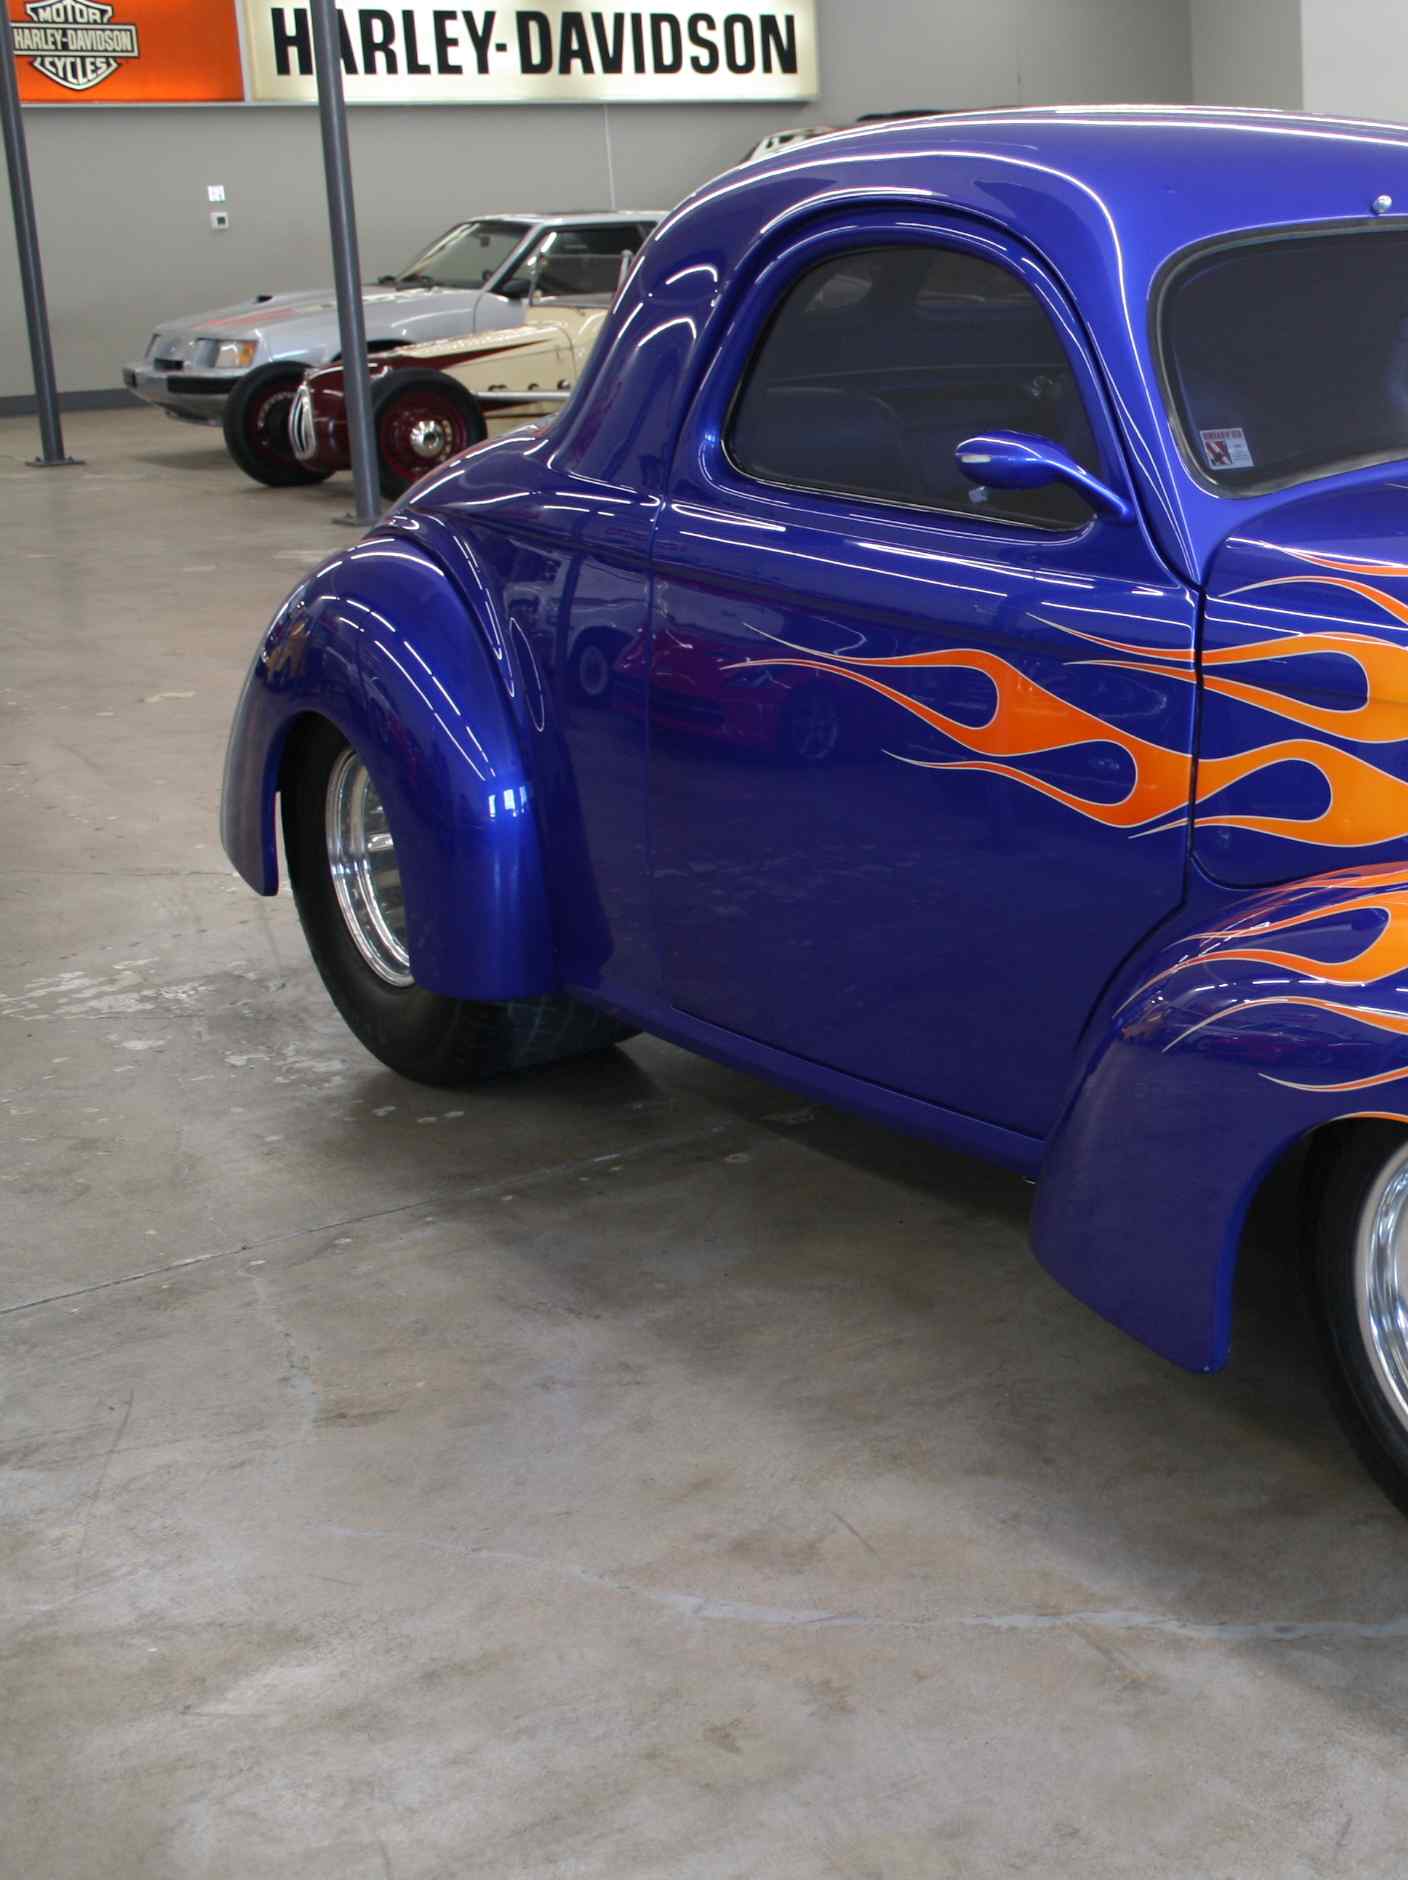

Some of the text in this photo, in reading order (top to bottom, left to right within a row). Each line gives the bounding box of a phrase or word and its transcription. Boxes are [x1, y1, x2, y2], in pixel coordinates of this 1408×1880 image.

[38, 0, 101, 23] MOTOR
[14, 28, 132, 51] HARLEY-DAVIDSON
[45, 57, 109, 84] CYCLES
